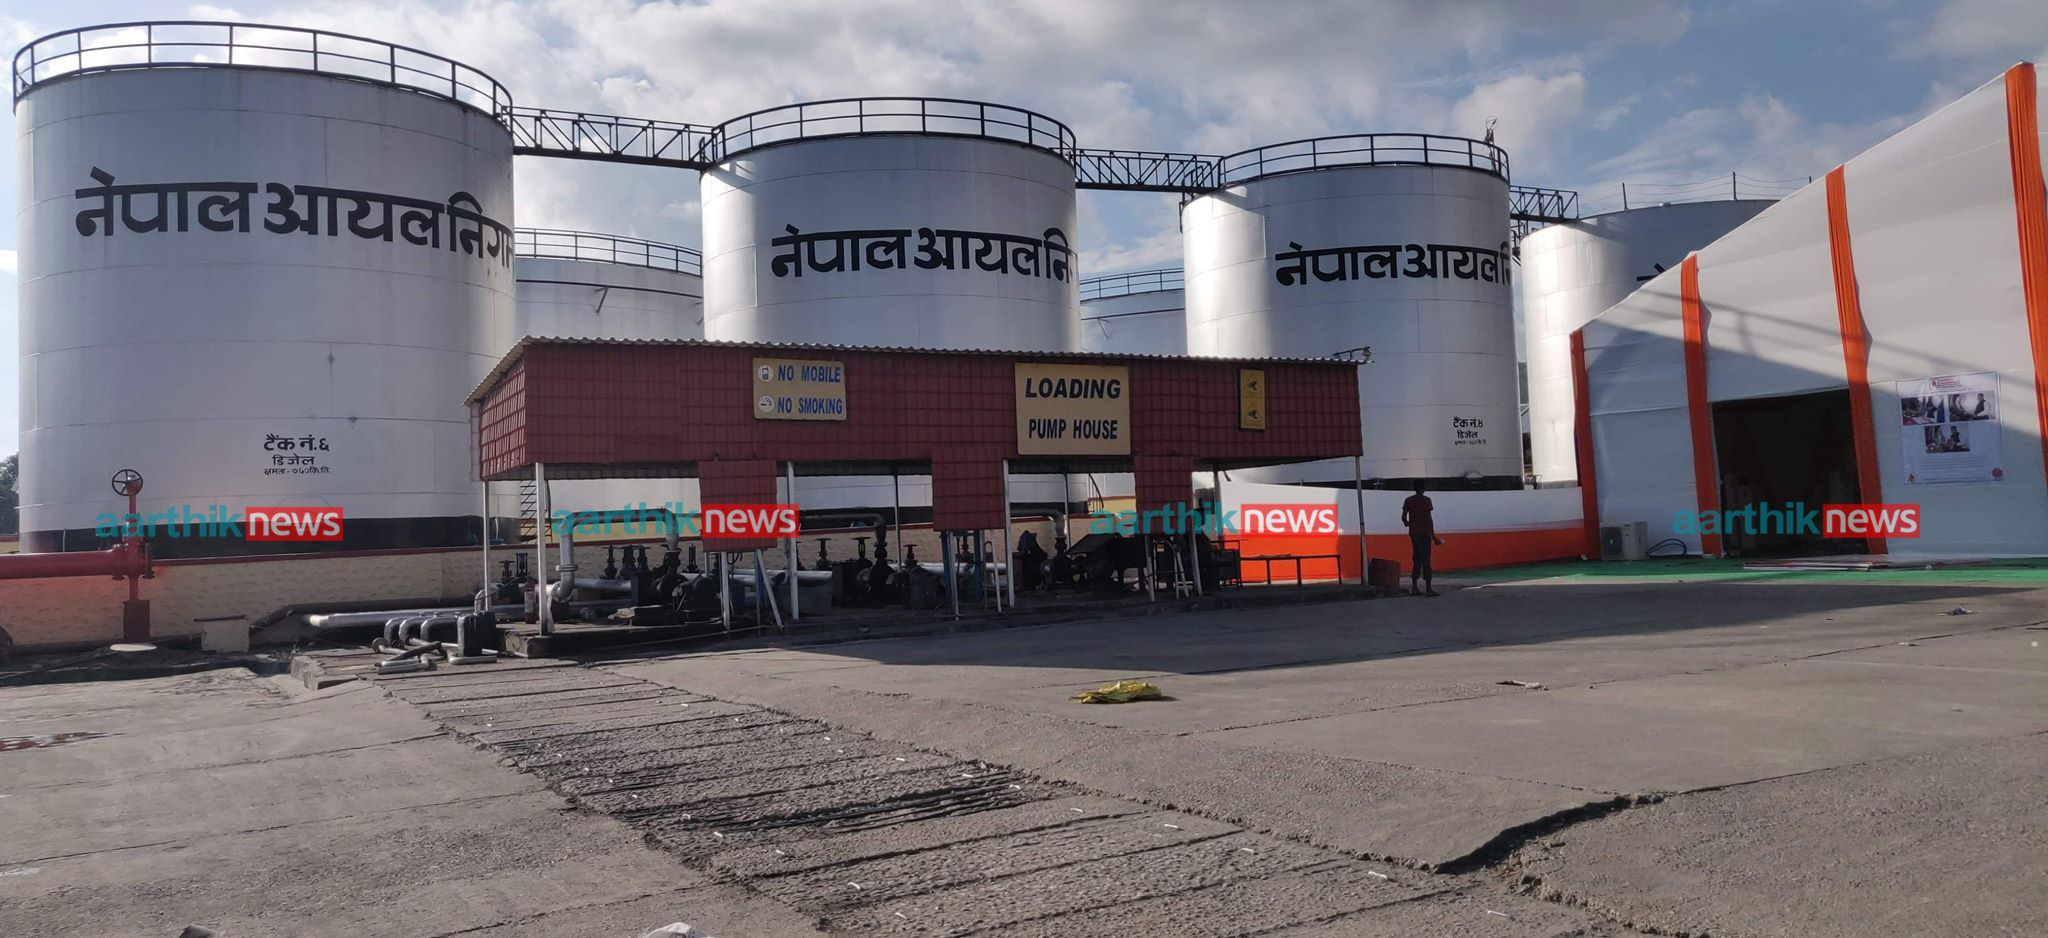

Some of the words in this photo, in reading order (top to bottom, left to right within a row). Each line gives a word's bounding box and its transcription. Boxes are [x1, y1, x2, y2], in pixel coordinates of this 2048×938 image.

[75, 166, 258, 237] नेपाल
[263, 182, 445, 248] आयल
[771, 223, 912, 278] नेपाल
[913, 227, 1042, 277] आयल
[1275, 241, 1402, 287] नेपाल
[1403, 243, 1498, 284] आयल
[777, 365, 794, 381] NO
[801, 366, 841, 382] MOBILE
[1025, 377, 1121, 399] LOADING
[777, 397, 793, 414] NO
[798, 397, 843, 414] SMOKING
[1028, 418, 1067, 439] PUMP
[1072, 419, 1118, 439] HOUSE
[264, 433, 296, 451] टैंक
[272, 453, 315, 466] डिजेल
